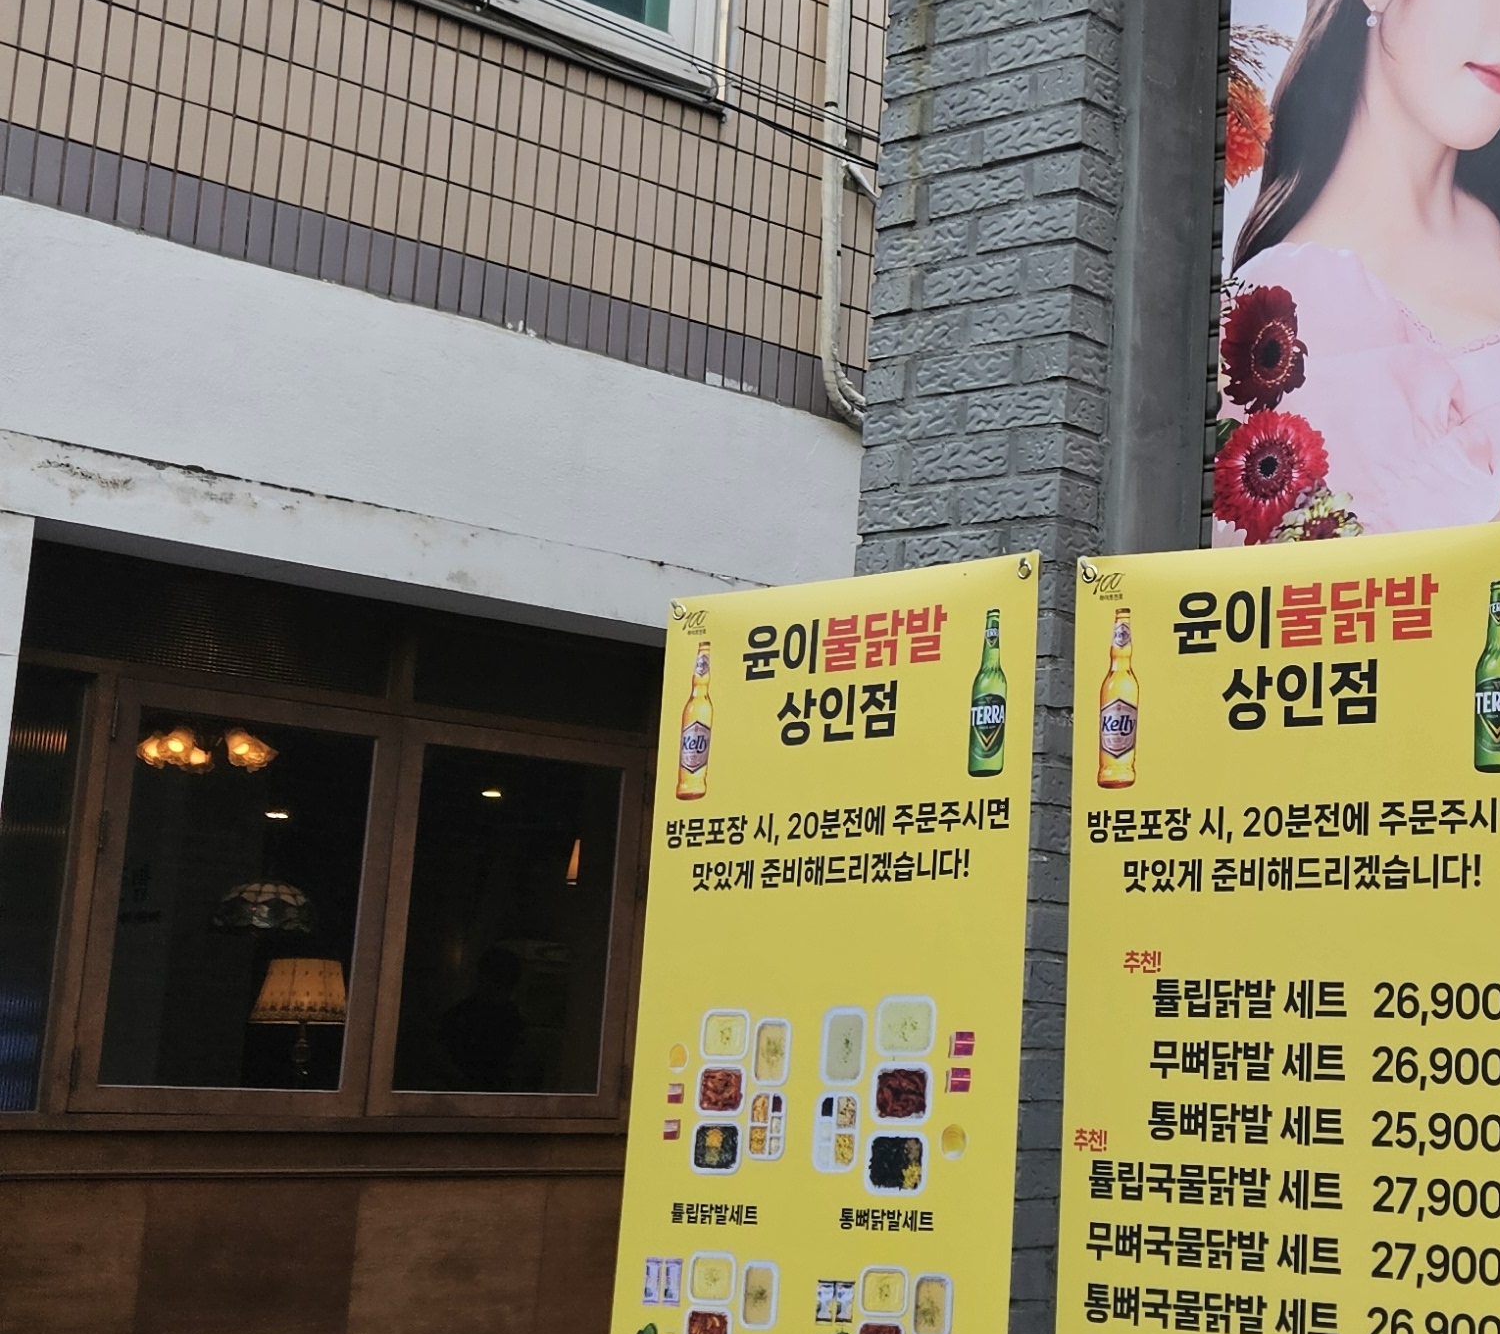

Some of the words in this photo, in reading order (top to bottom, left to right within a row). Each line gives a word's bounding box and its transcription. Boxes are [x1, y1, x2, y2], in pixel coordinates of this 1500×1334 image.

[1174, 574, 1438, 654] 윤이불닭발
[743, 605, 947, 681] 윤이불닭발
[777, 680, 897, 746] 상인점
[1222, 659, 1377, 730] 상인점
[971, 704, 1005, 727] TERRA
[1101, 713, 1136, 738] Kelly
[682, 735, 708, 754] Kelly
[667, 815, 748, 848] 방문포장
[754, 813, 779, 845] 시,
[787, 805, 885, 839] 20분전에
[893, 797, 1009, 835] 주문주시면
[1088, 807, 1191, 843] 방문포장
[1199, 806, 1232, 843] 시,
[1243, 802, 1369, 838] 20분전에
[693, 860, 754, 891] 맛있게
[761, 848, 969, 888] 준비해드리겠습니다!
[1124, 859, 1202, 893] 맛있게
[1212, 853, 1480, 892] 준비해드리겠습니다!
[1123, 950, 1162, 973] 추천!
[1153, 979, 1275, 1018] 튤립닭발
[1284, 980, 1347, 1019] 세트
[1150, 1041, 1274, 1081] 무뼈닭발
[1282, 1043, 1345, 1082] 세트
[1073, 1128, 1108, 1152] 추천!
[1148, 1101, 1272, 1144] 통뼈닭발
[1280, 1106, 1344, 1146] 세트
[1089, 1160, 1270, 1208] 튤립국물닭발
[1279, 1170, 1342, 1210] 세트
[671, 1203, 757, 1225] 튤립닭발세트
[839, 1208, 933, 1232] 통뼈닭발세트
[1086, 1222, 1269, 1272] 무뼈국물닭발
[1277, 1234, 1341, 1275] 세트
